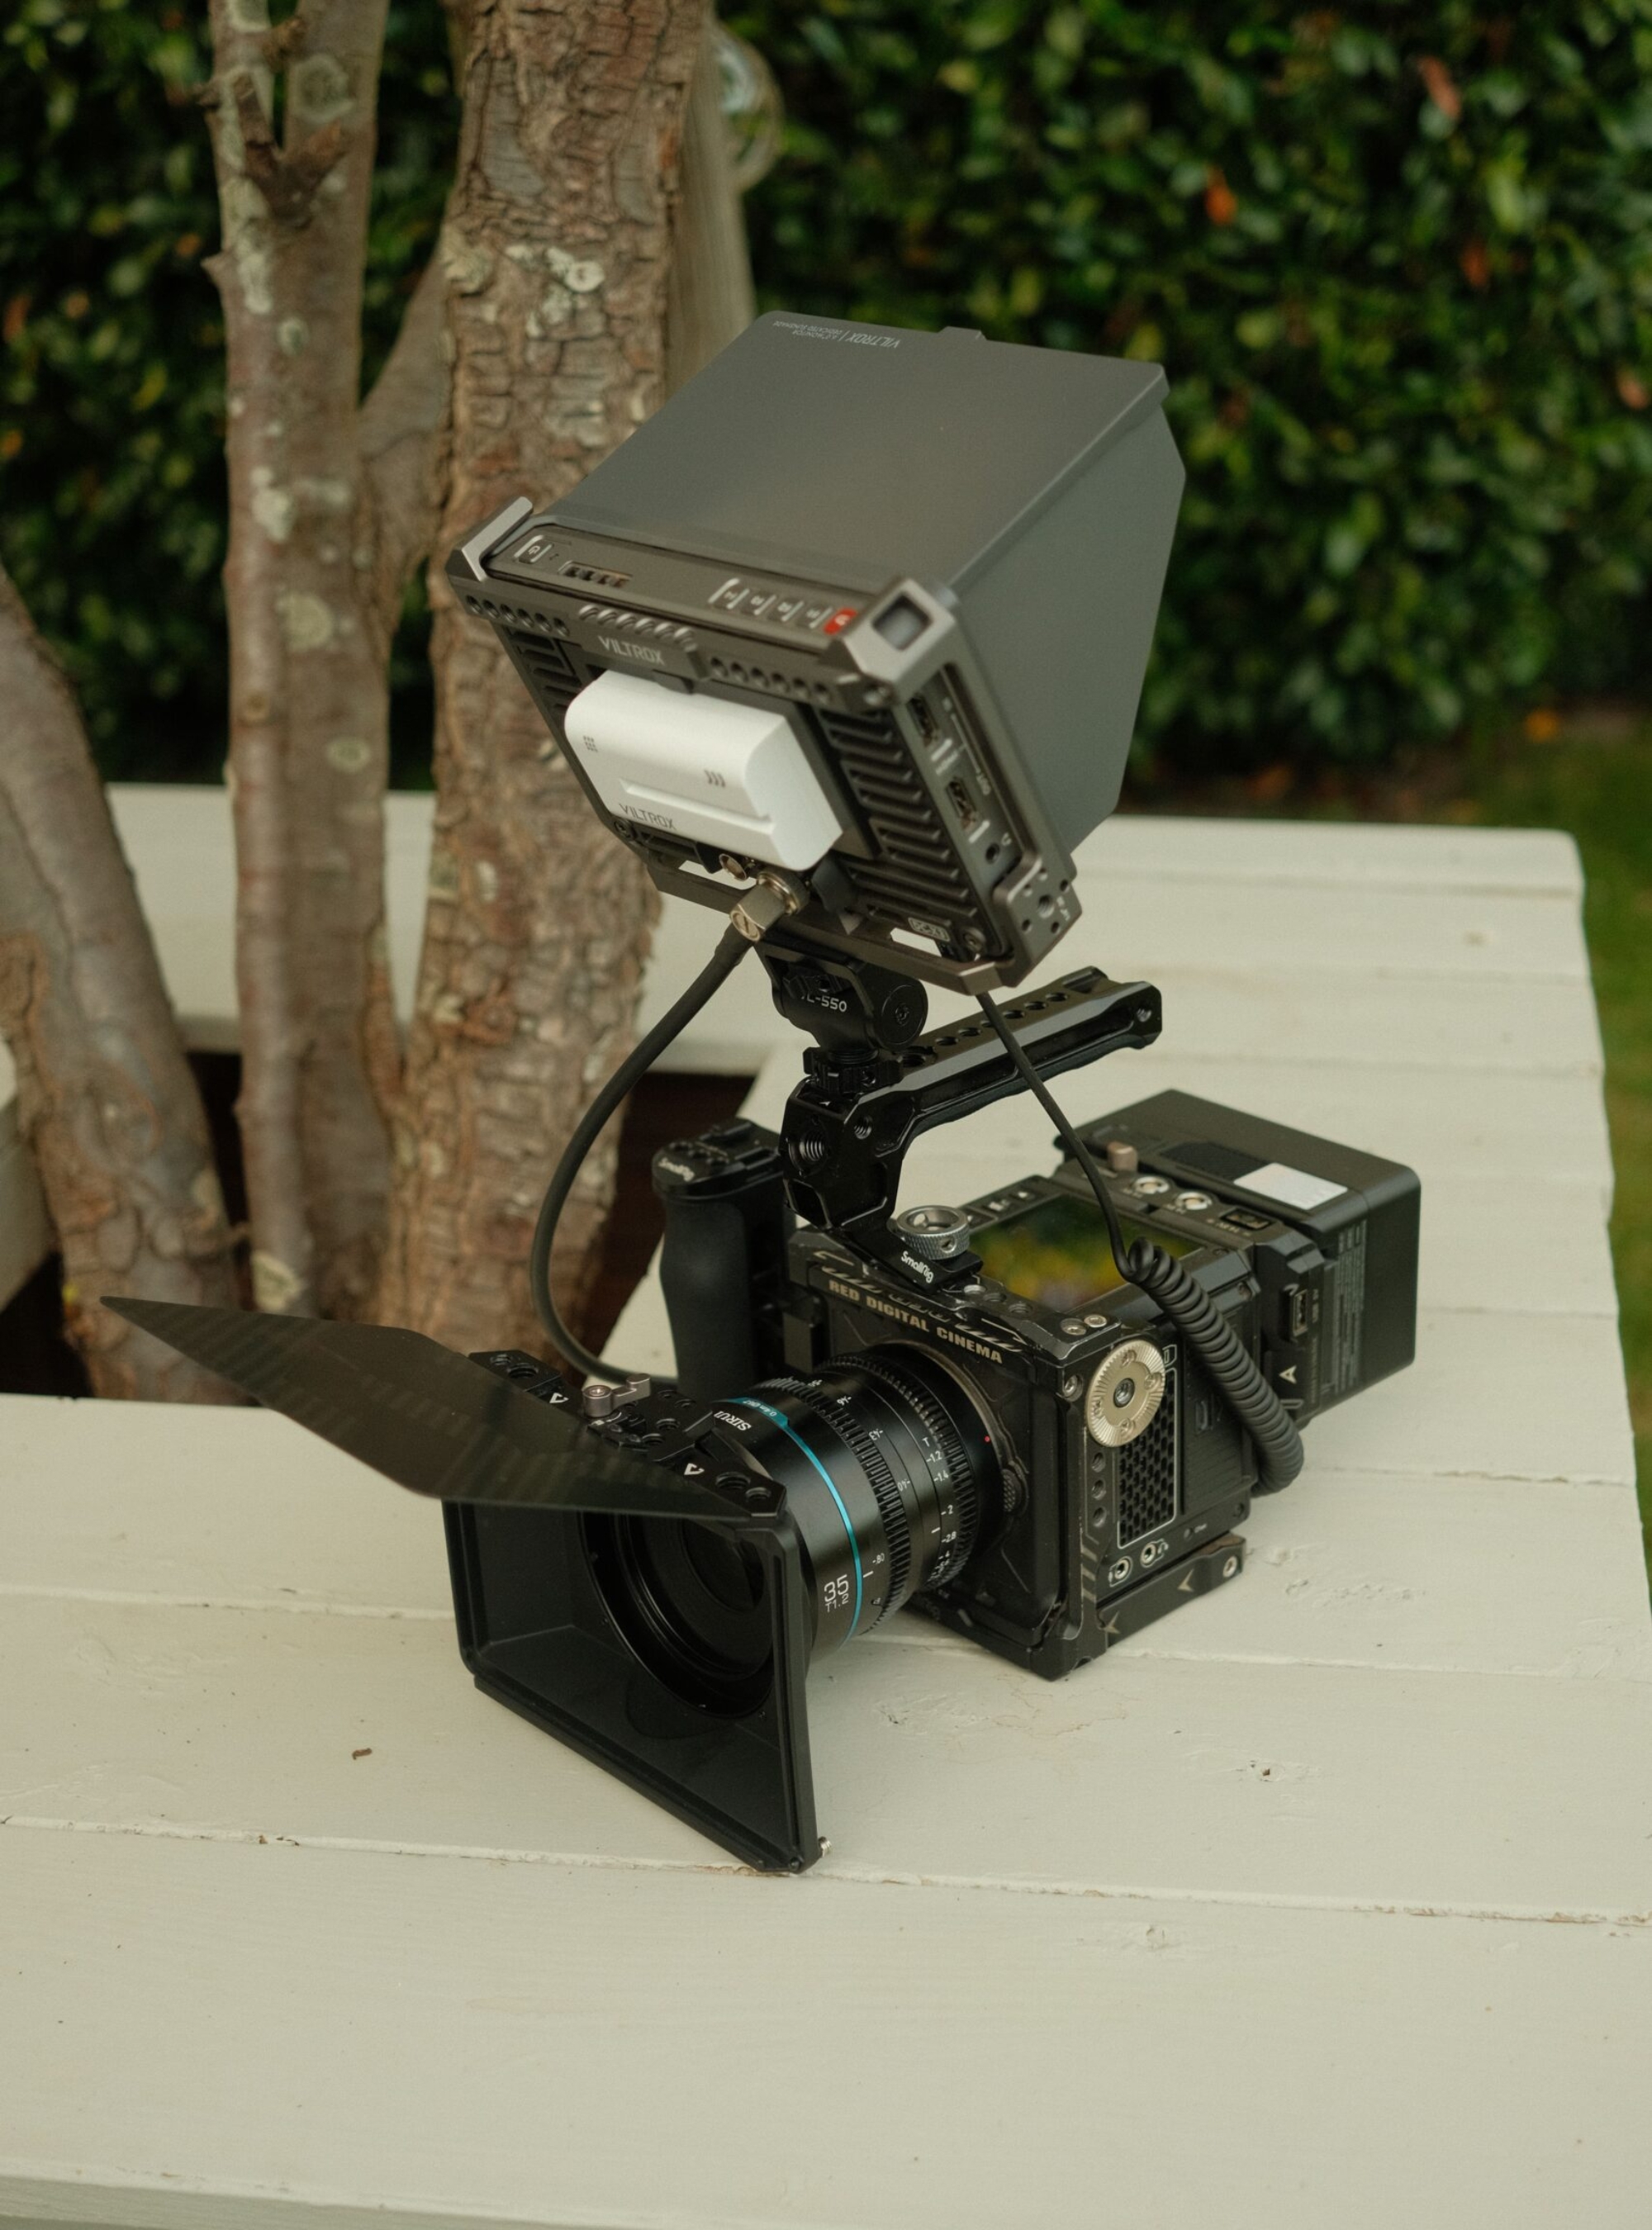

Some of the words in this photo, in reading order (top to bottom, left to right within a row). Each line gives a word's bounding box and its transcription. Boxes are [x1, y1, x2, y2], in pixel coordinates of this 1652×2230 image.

[845, 332, 901, 349] VILTROX
[598, 634, 665, 666] VILTROX
[619, 801, 677, 831] VILTROX
[801, 994, 847, 1013] L-550
[828, 1280, 861, 1302] RED
[866, 1296, 929, 1332] DIGITAL
[937, 1326, 1003, 1364] CINEMA
[714, 1411, 752, 1431] SIRUI
[824, 1573, 849, 1602] 35
[825, 1593, 849, 1613] T1.2
